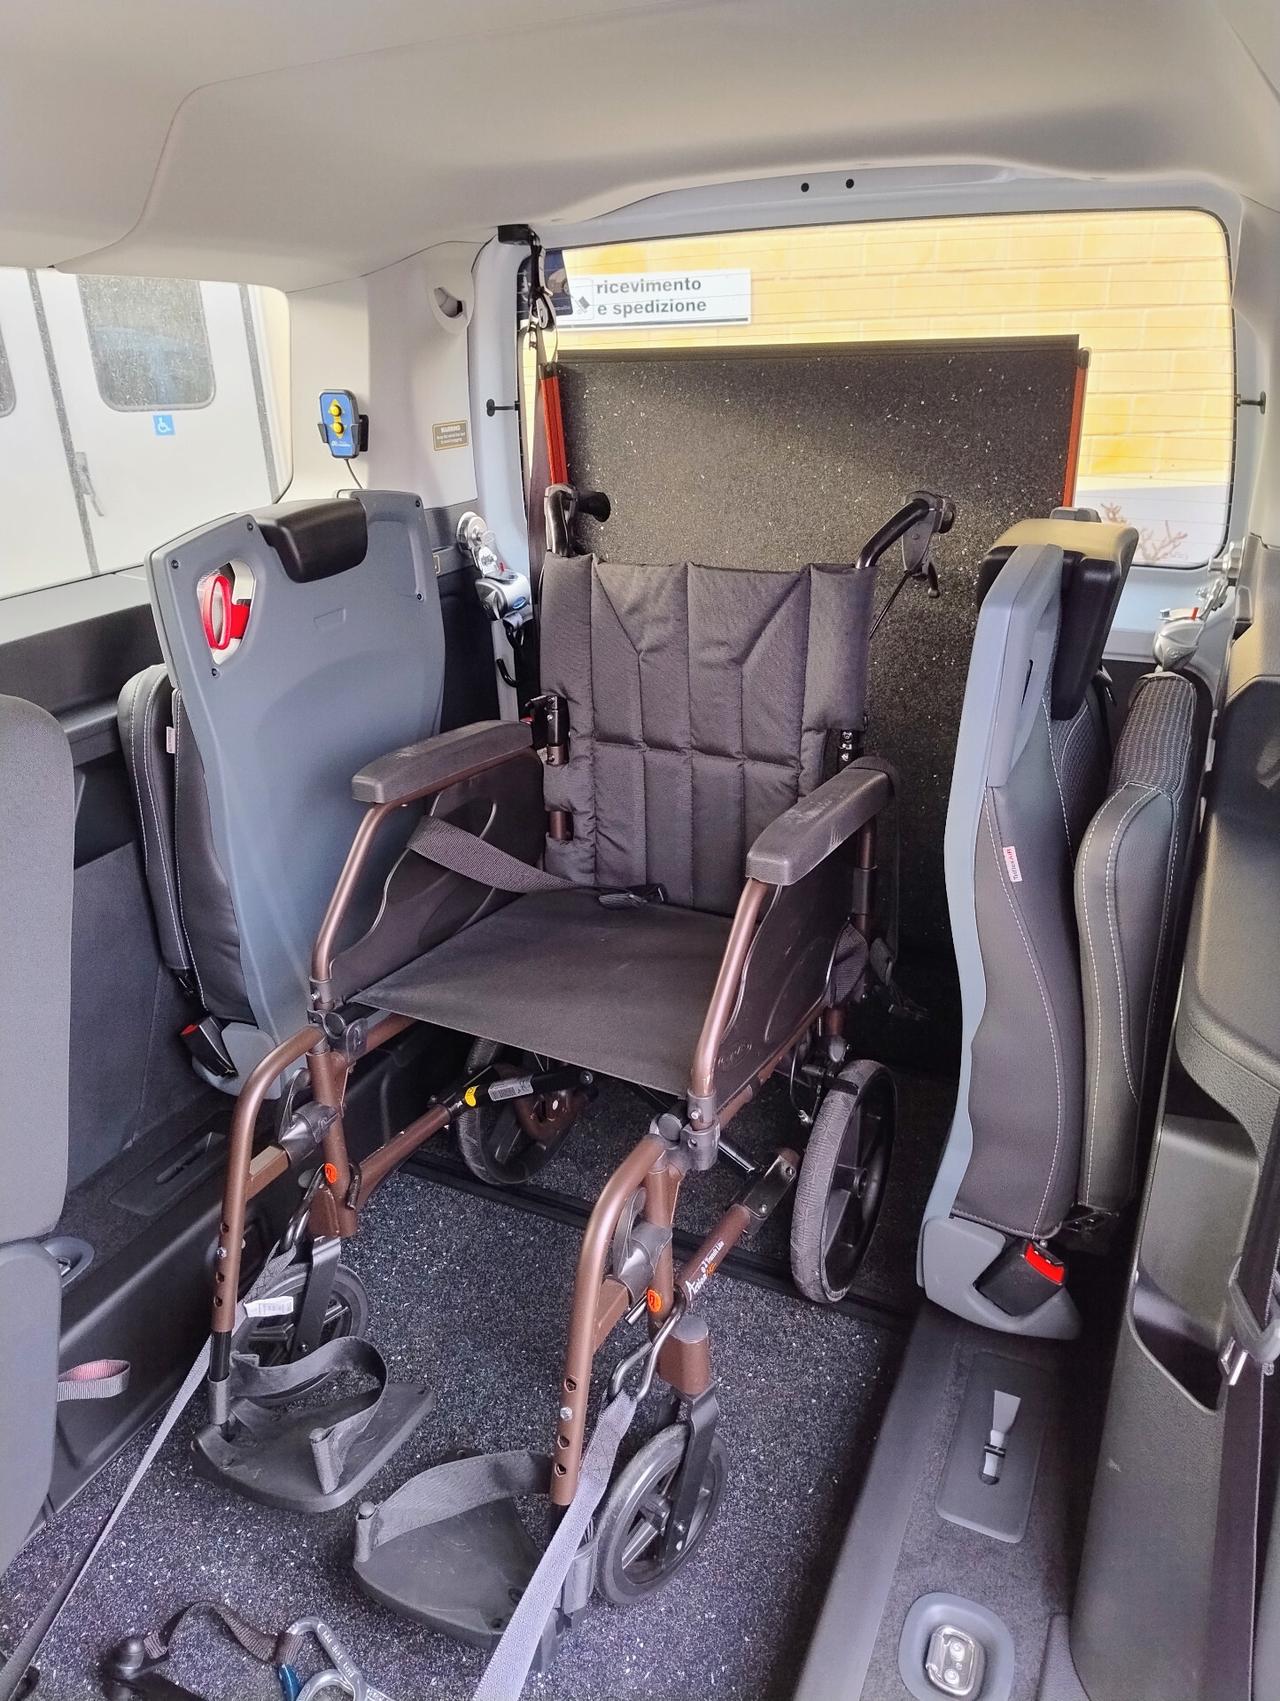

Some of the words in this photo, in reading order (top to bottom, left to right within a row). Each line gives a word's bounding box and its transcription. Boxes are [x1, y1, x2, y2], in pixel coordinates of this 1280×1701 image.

[596, 278, 702, 294] ricevimento
[597, 304, 607, 315] e
[612, 299, 707, 318] spedizione
